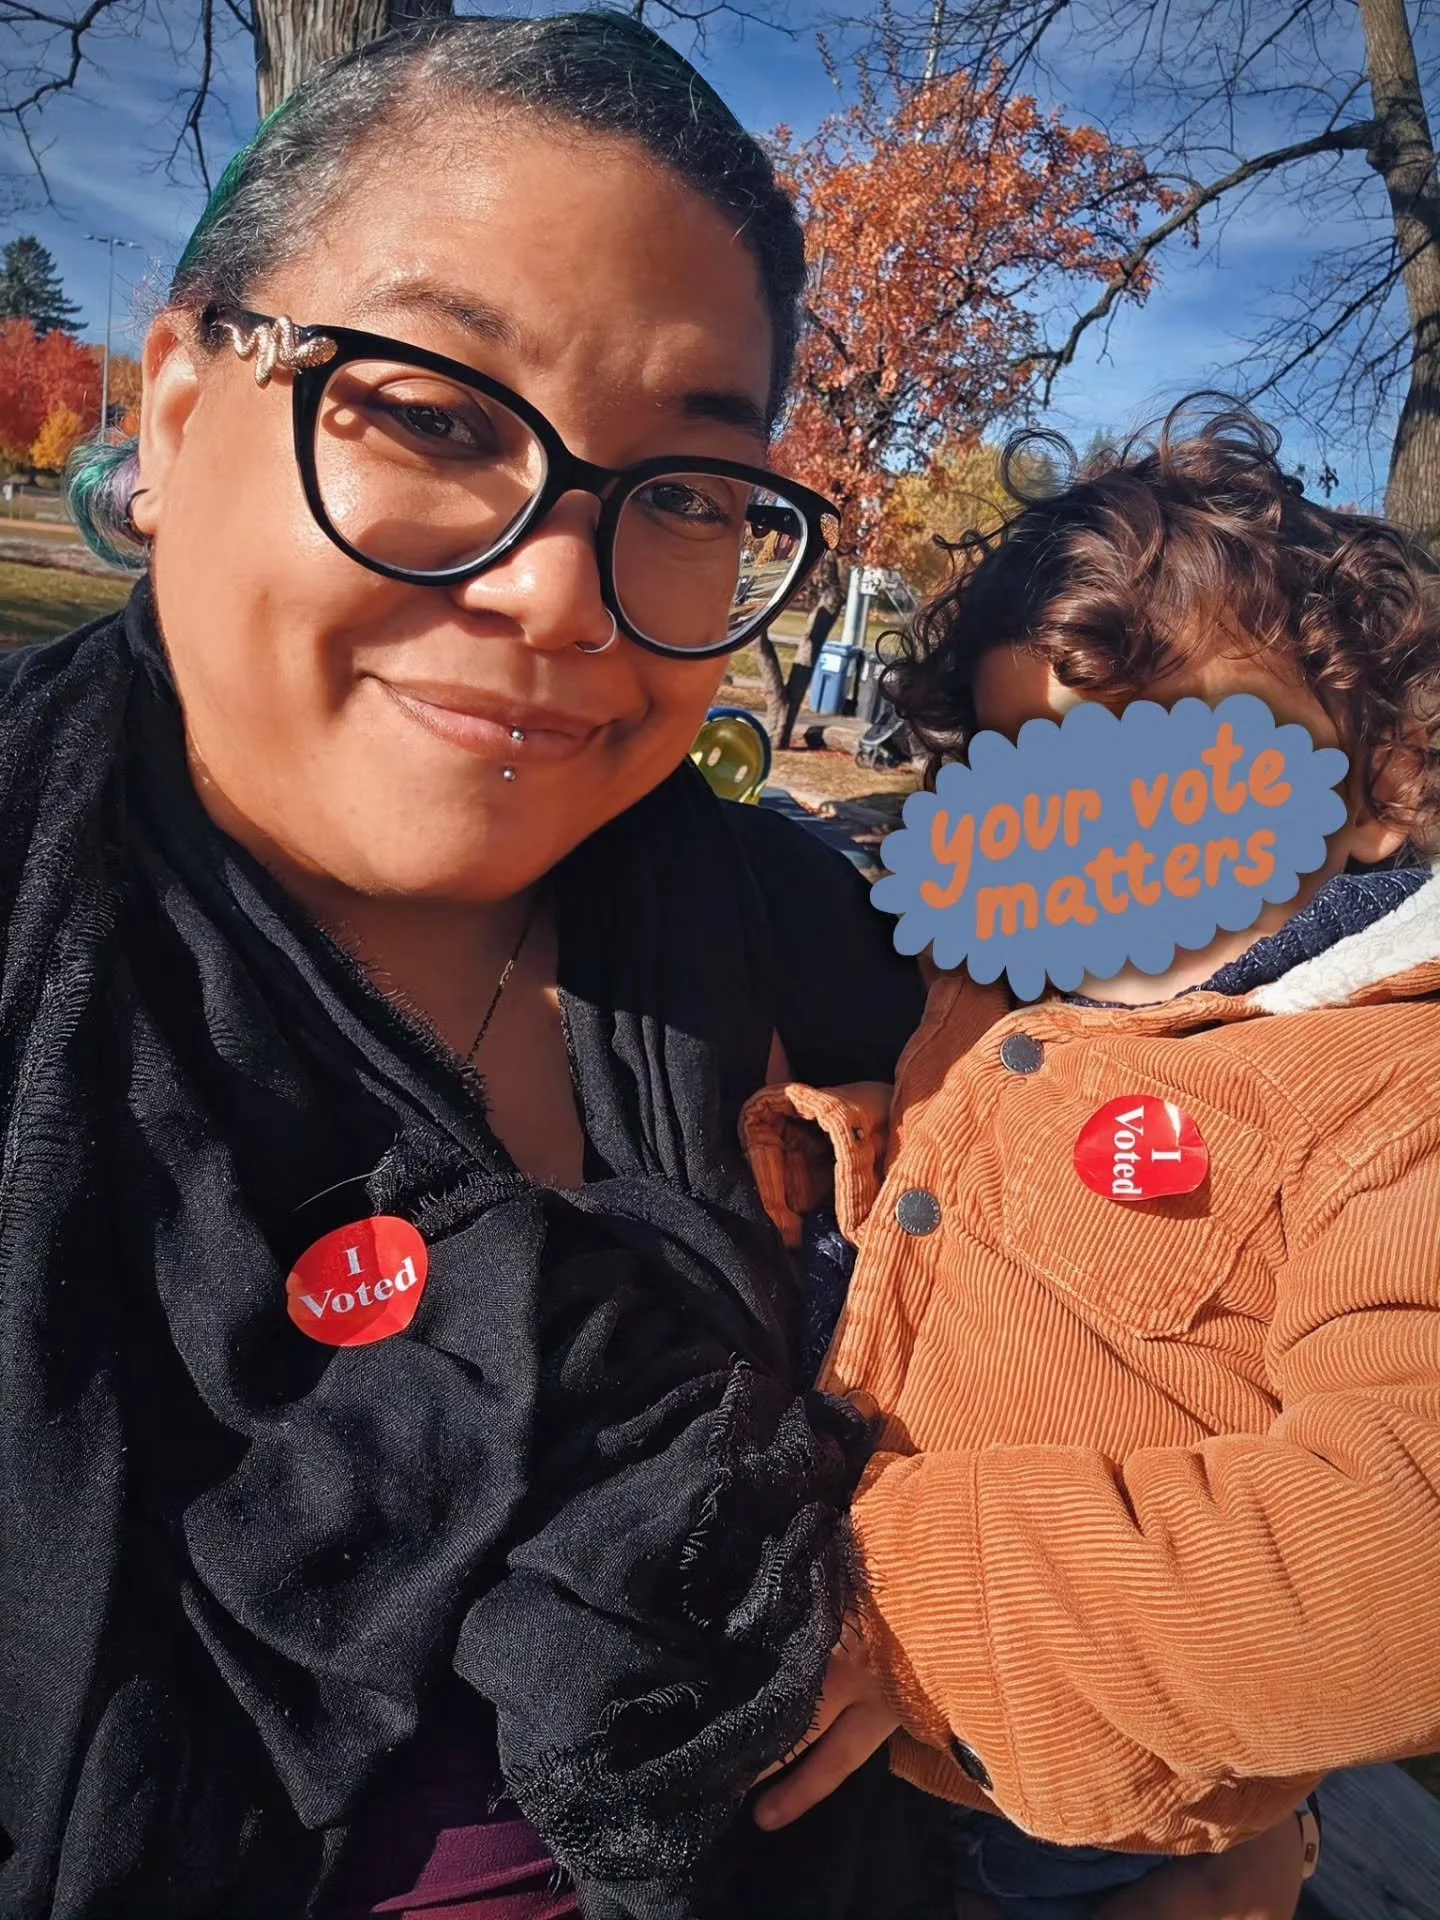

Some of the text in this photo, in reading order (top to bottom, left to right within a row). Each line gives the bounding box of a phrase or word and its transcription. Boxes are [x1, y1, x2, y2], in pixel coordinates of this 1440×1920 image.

[1112, 1105, 1145, 1195] Voted
[1151, 1148, 1182, 1163] I
[342, 1245, 366, 1277] I
[299, 1256, 419, 1319] Voted
